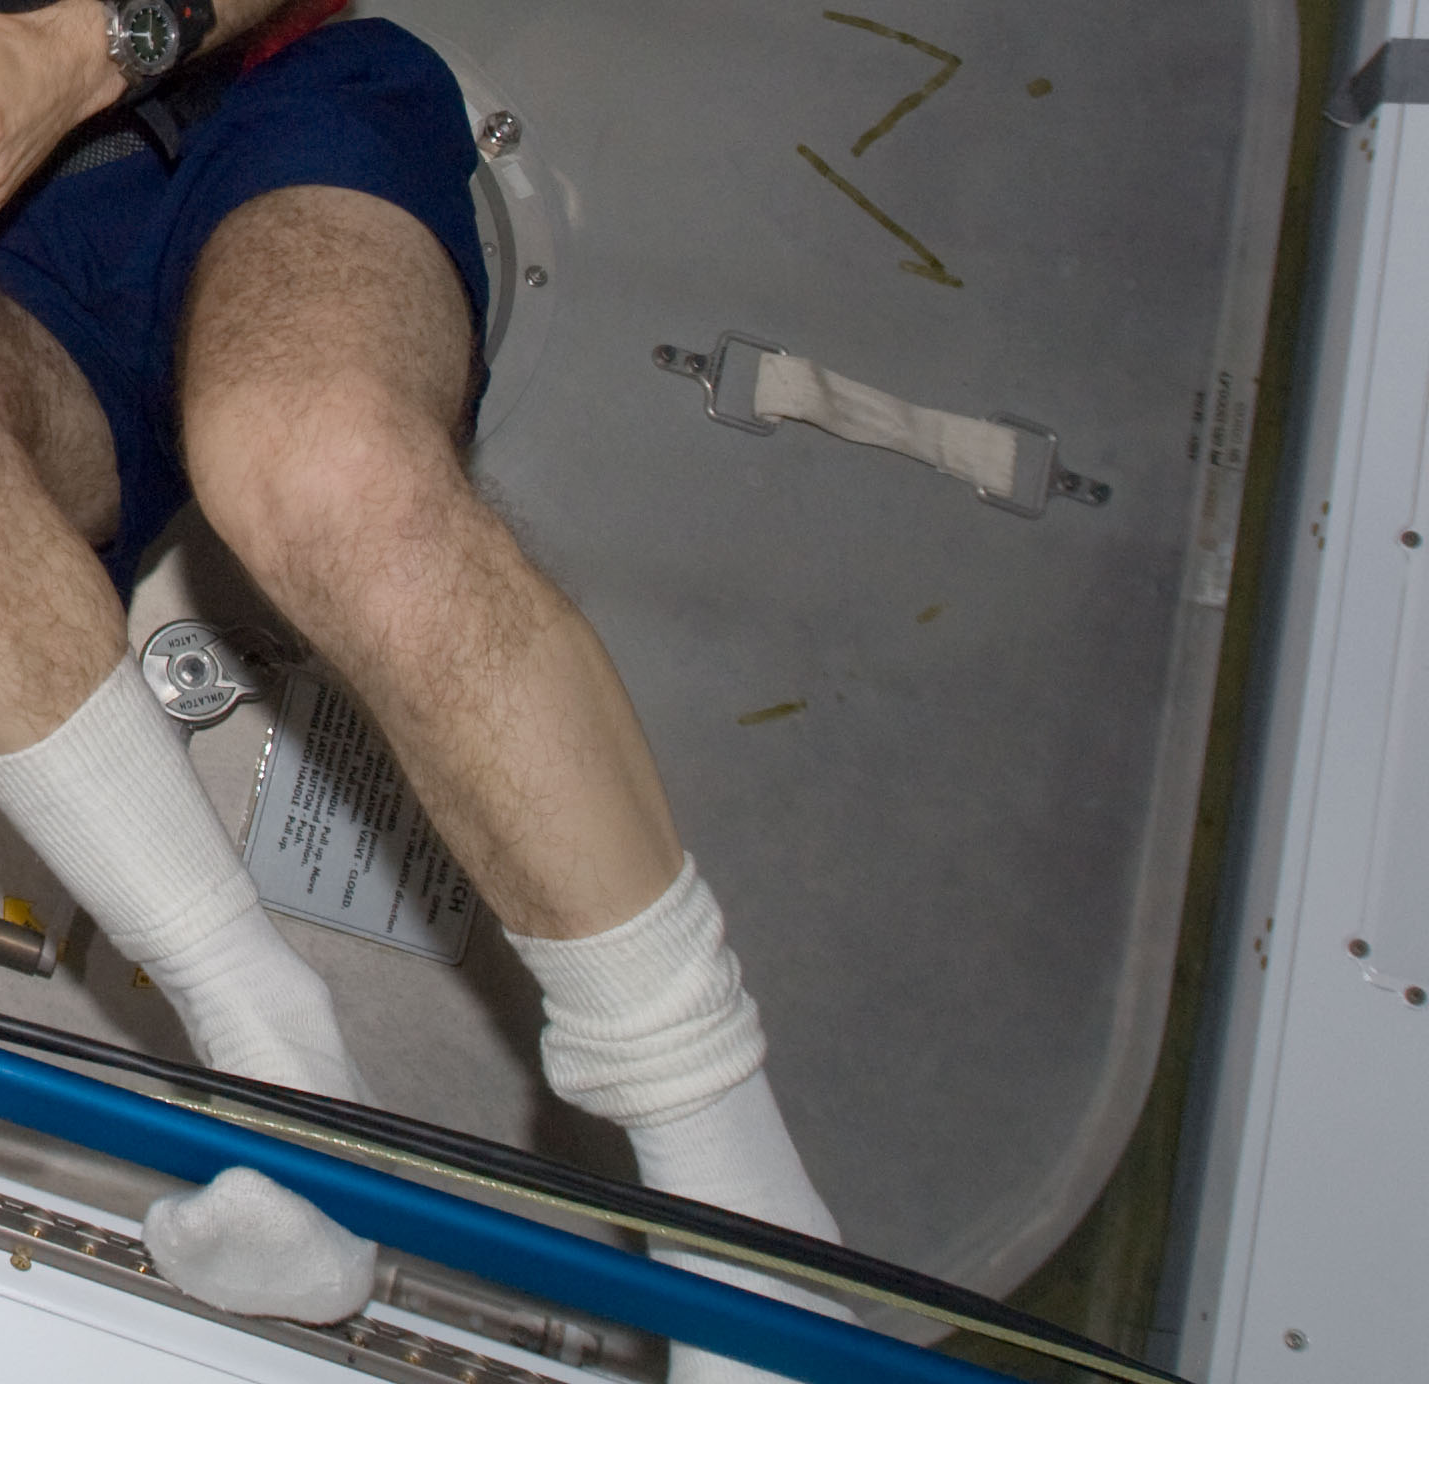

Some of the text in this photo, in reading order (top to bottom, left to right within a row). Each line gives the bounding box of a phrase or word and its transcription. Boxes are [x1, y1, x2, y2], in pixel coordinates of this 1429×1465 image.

[168, 633, 197, 648] LATCH
[179, 692, 224, 710] UNLATCH
[276, 731, 315, 853] LATCH HANDLE Pull up.
[292, 734, 328, 848] LATCH BUTTON Push.
[322, 772, 330, 784] to
[325, 775, 343, 817] HANDLE
[311, 785, 329, 823] stowed
[298, 824, 318, 868] position.
[318, 825, 332, 846] Pull
[353, 828, 369, 860] VALVE
[360, 832, 380, 876] position.
[312, 845, 324, 865] up.
[305, 865, 320, 895] Move
[339, 868, 358, 911] CLOSED.
[384, 889, 402, 933] direction
